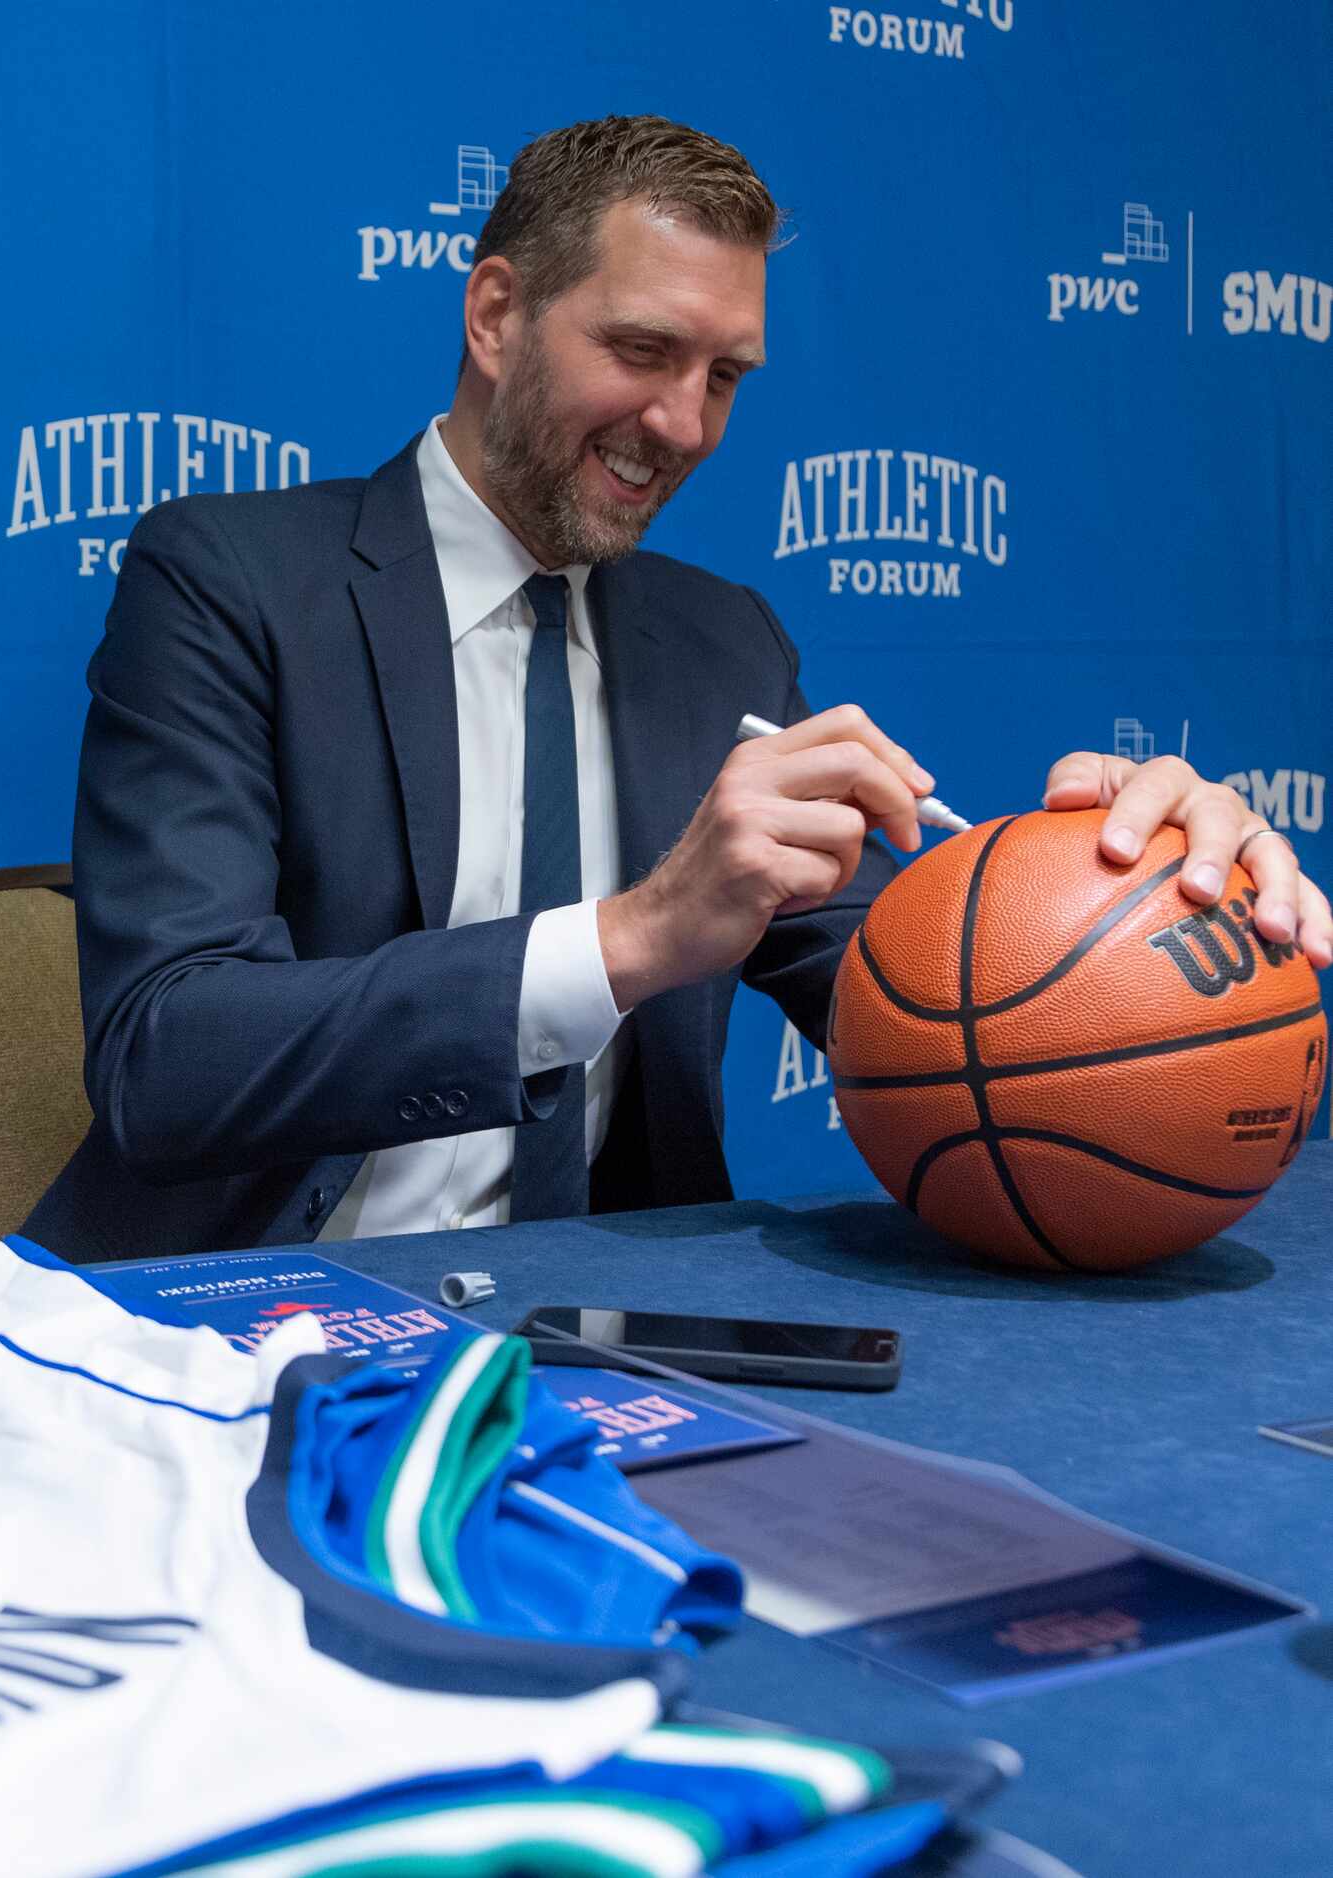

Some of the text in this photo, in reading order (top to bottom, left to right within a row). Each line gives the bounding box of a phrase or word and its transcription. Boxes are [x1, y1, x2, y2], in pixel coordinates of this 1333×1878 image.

[828, 6, 965, 59] FORUM
[357, 226, 477, 281] pwc
[1048, 270, 1333, 343] pwc SMU
[773, 449, 1008, 567] ATHLETIC
[828, 558, 961, 598] FORUM
